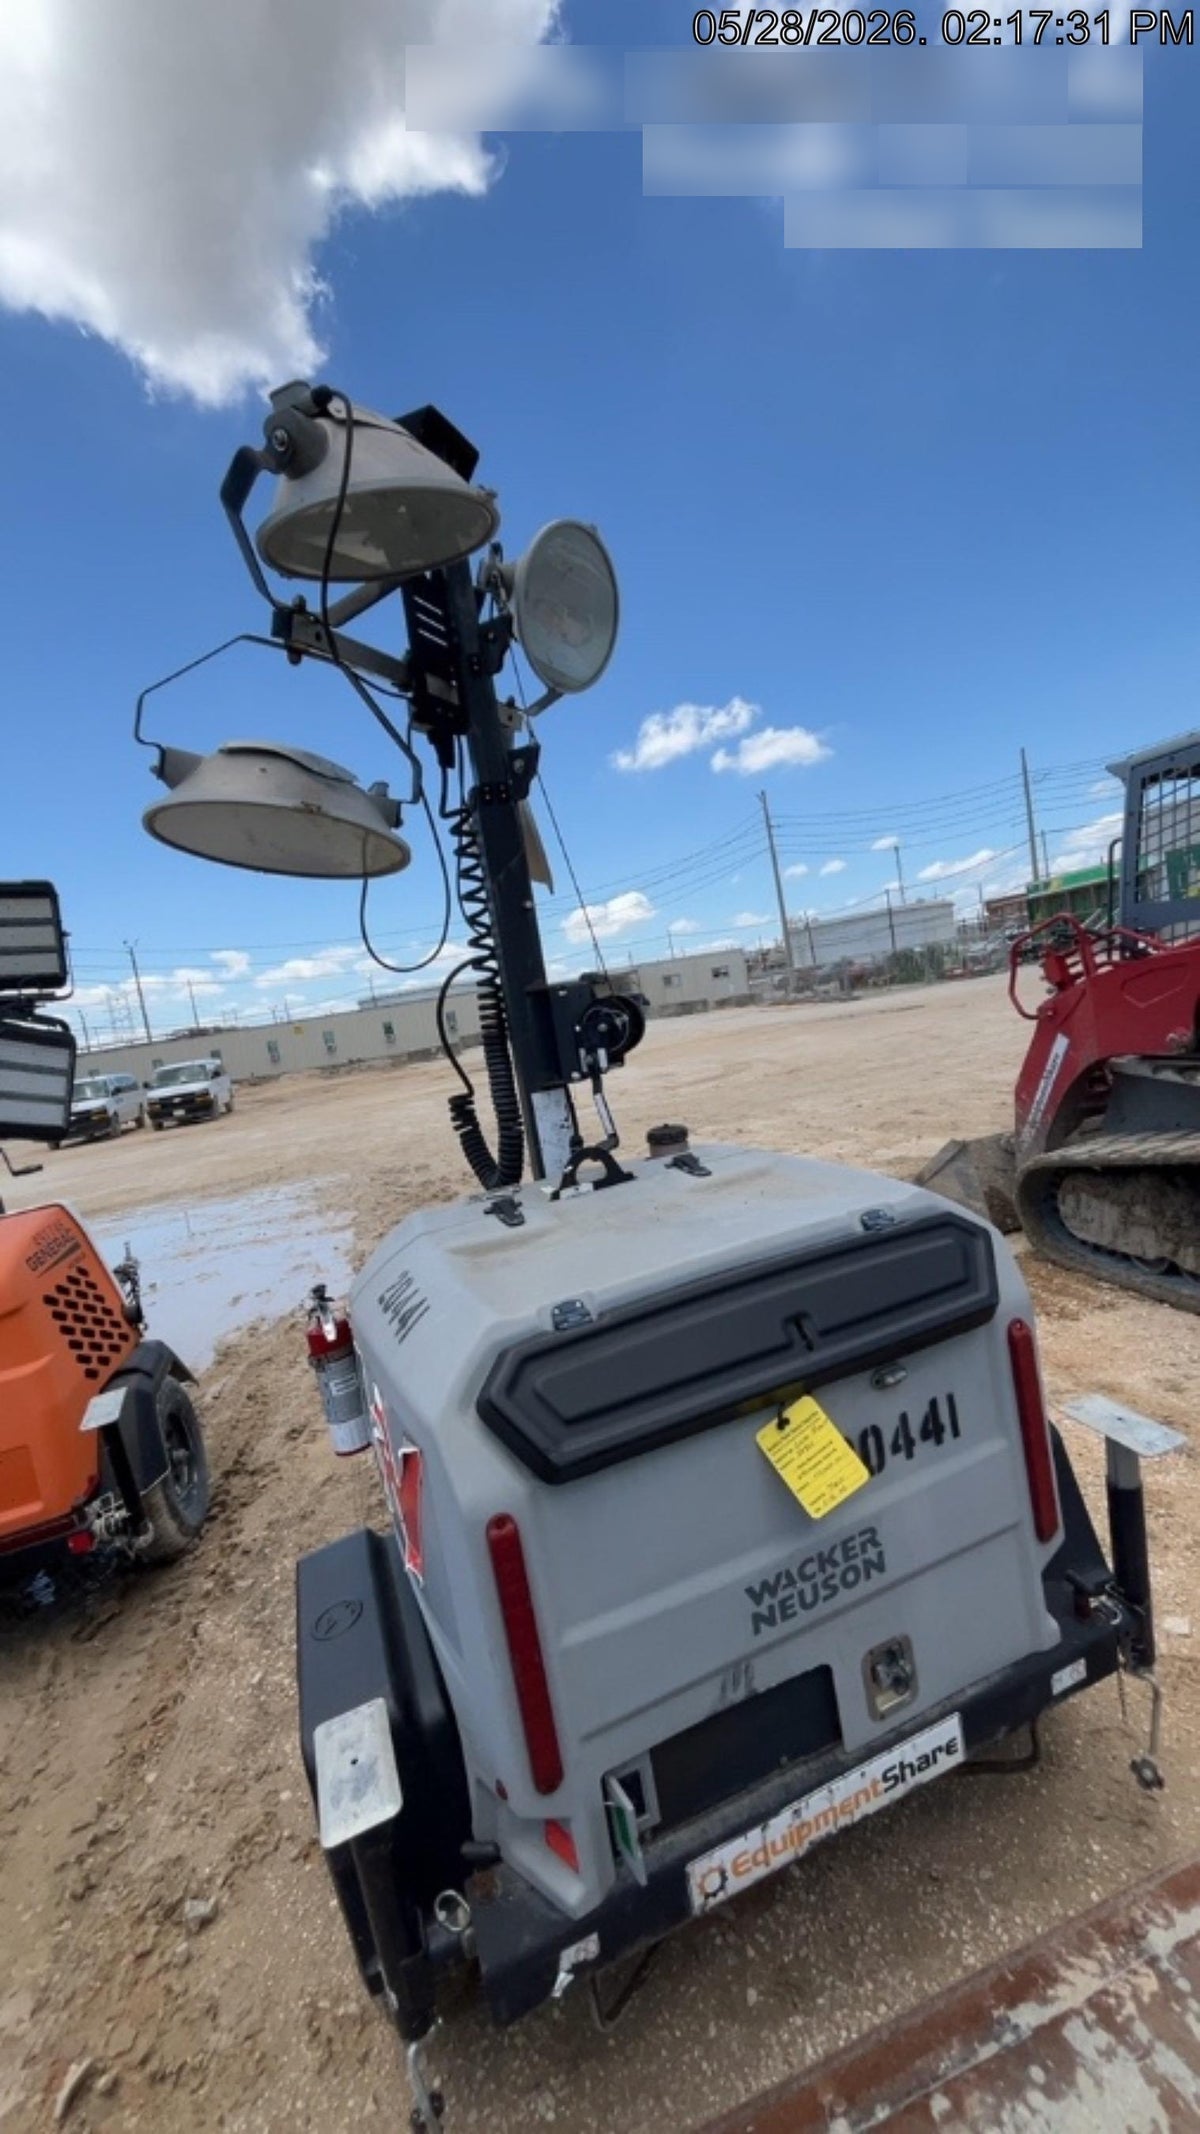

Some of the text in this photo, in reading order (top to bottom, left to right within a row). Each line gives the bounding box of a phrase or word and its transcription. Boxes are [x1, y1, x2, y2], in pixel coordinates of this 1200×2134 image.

[845, 1391, 960, 1477] 0441
[744, 1526, 883, 1606] WACKER
[751, 1550, 886, 1636] NEUSON
[730, 1736, 959, 1878] EquipmentShare
